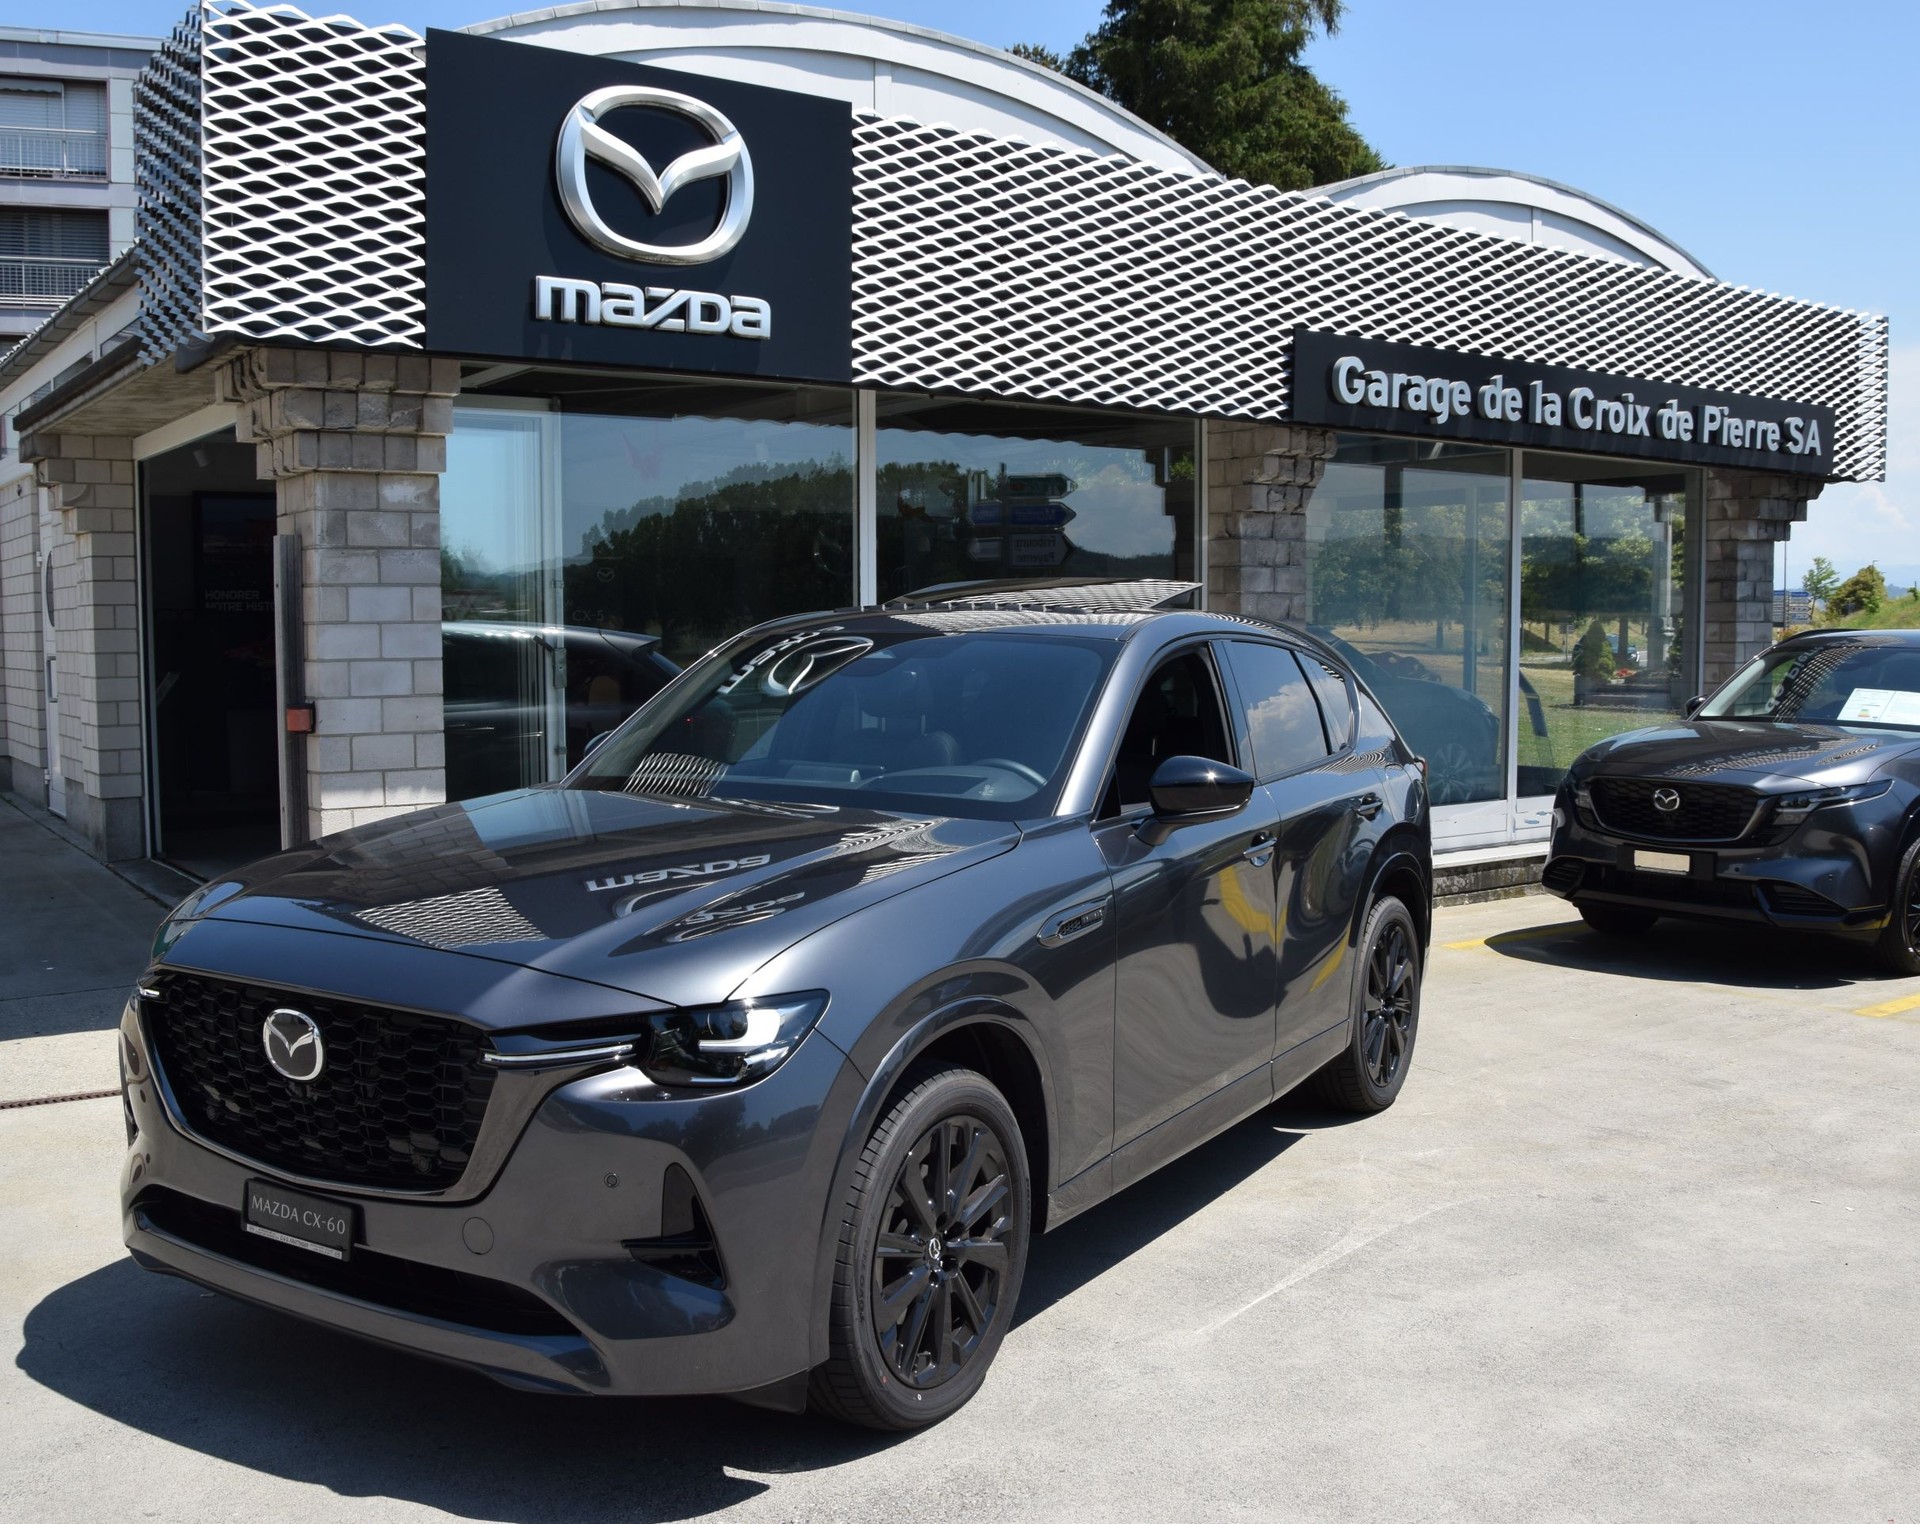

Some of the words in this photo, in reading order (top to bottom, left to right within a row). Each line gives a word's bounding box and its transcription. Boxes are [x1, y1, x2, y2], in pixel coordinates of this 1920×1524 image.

[1332, 356, 1471, 424] Garage
[1478, 375, 1523, 422] de
[1529, 380, 1561, 426] la
[1568, 387, 1650, 436] Croix
[1656, 399, 1694, 441] de
[1702, 405, 1780, 452] Pierre
[1783, 416, 1822, 456] SA
[205, 590, 260, 600] HONORER
[572, 609, 605, 622] CX-5
[251, 1195, 299, 1223] MAZDA
[303, 1211, 346, 1235] CX-60
